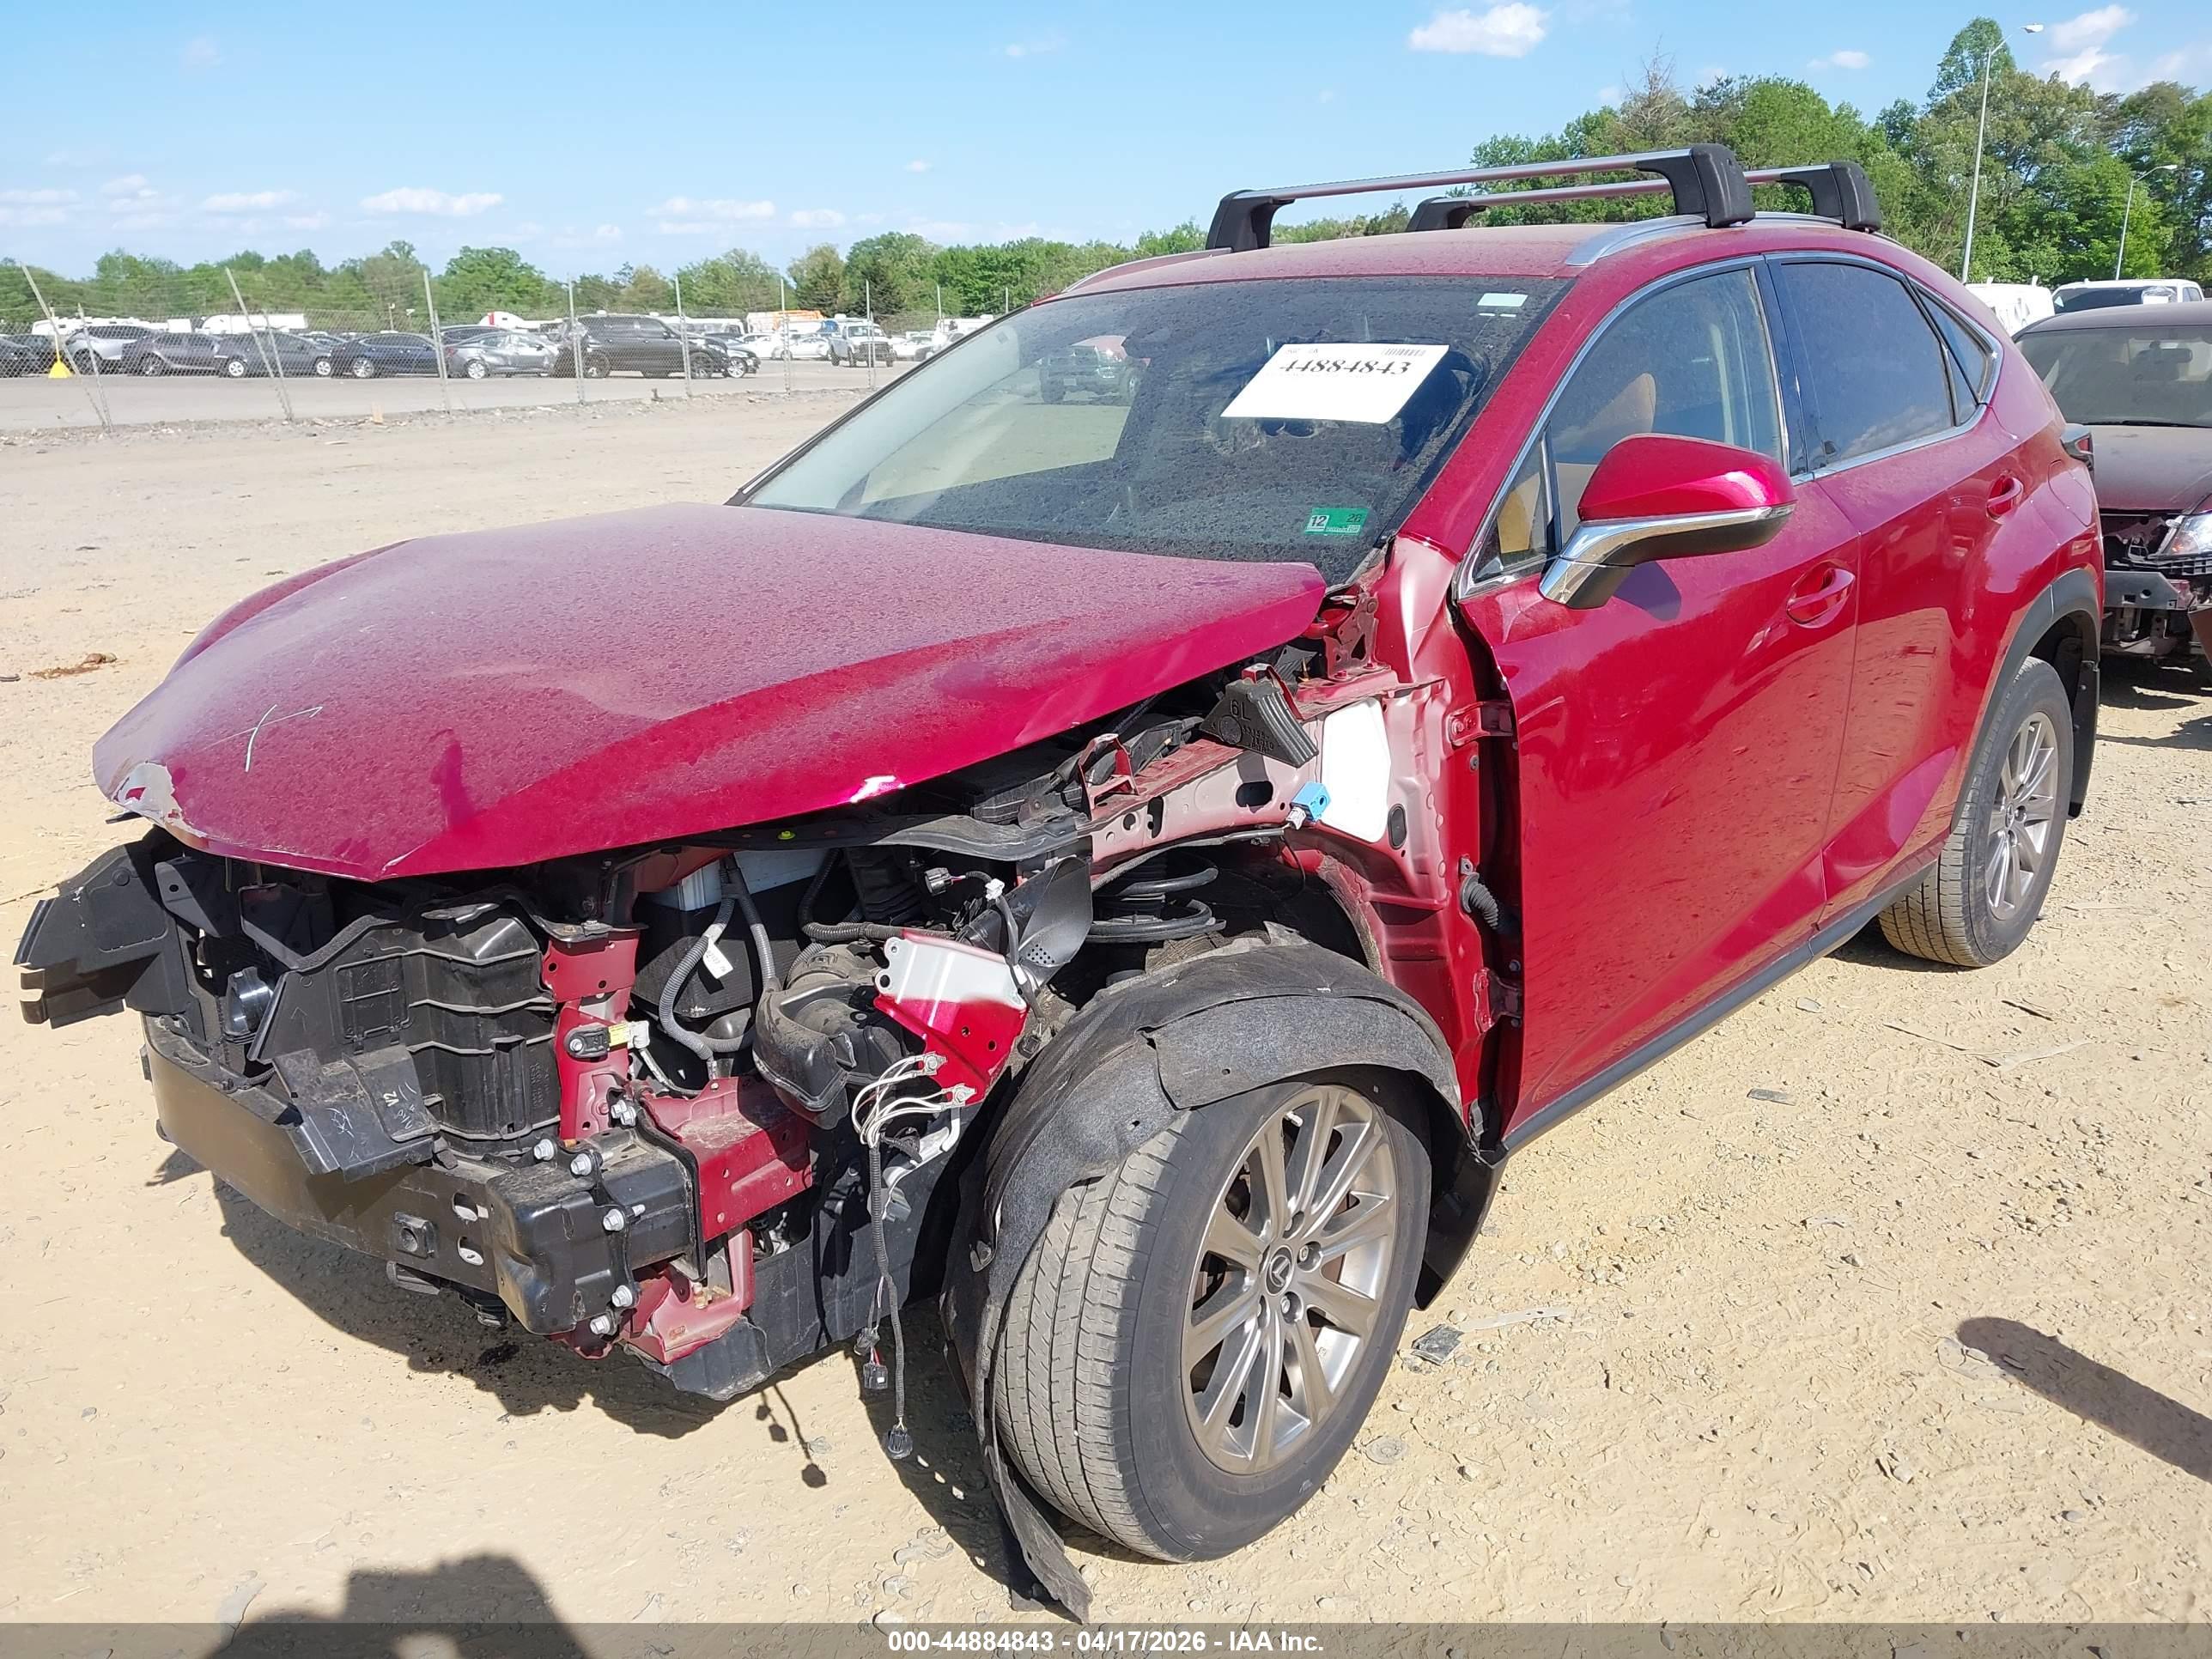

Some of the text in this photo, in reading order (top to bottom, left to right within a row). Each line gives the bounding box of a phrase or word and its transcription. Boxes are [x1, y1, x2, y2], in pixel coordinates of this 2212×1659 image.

[1279, 359, 1412, 375] 44884843
[1310, 515, 1328, 527] 12
[1229, 700, 1251, 721] 6L
[383, 1091, 399, 1107] V2
